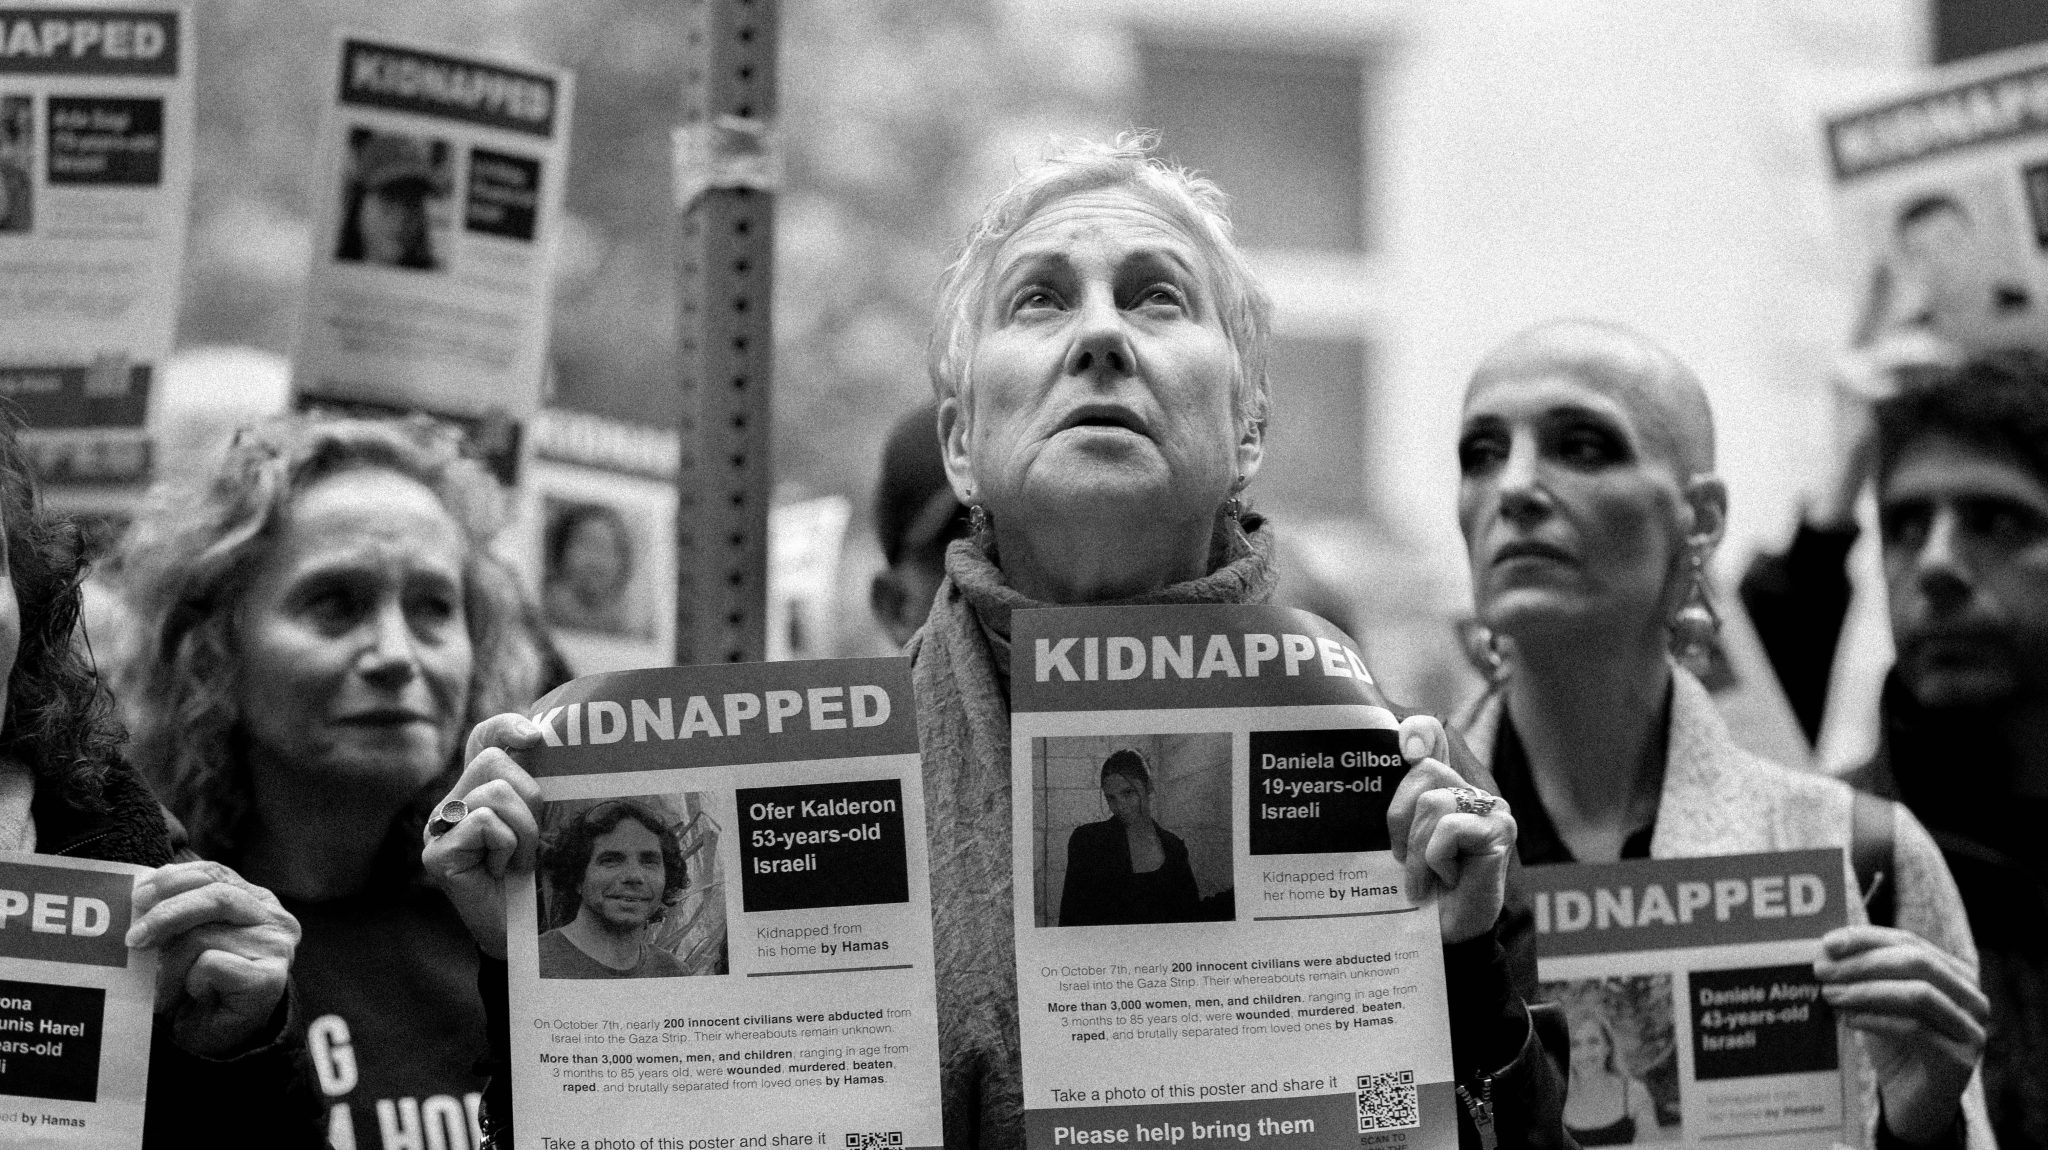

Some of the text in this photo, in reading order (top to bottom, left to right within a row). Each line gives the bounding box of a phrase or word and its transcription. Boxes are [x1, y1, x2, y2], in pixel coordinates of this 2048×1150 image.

[0, 19, 165, 60] APPED
[1034, 633, 1374, 685] KIDNAPPED
[531, 684, 891, 747] KIDNAPPED
[1262, 751, 1401, 769] Daniela Gilboa
[1262, 776, 1381, 797] 19-years-old
[749, 798, 895, 820] Ofer Kalderon
[1262, 802, 1319, 819] Israeli
[752, 822, 880, 849] 53-years-old
[753, 854, 816, 873] Israeli
[1262, 869, 1367, 883] Kidnapped from
[1264, 885, 1397, 900] her home by Hamas
[1534, 874, 1826, 934] IDNAPPED
[757, 923, 861, 939] Kidnapped from
[758, 940, 888, 957] his home by Hamas
[1041, 966, 1056, 976] On
[1061, 966, 1105, 975] October
[1134, 963, 1167, 974] nearly
[1171, 962, 1191, 972] 200
[1196, 961, 1247, 972] innocent
[1251, 959, 1299, 969] civilians
[1303, 957, 1332, 966] were
[1336, 952, 1390, 965] abducted
[1394, 950, 1418, 960] from
[1059, 970, 1346, 990] Israel into the Gaza Their whereabouts remain
[0, 997, 31, 1010] ona
[1048, 985, 1417, 1012] More than 3,000 women, men, and ranging in age from
[39, 1019, 84, 1036] Harel
[534, 1018, 549, 1028] On
[553, 1018, 597, 1029] October
[627, 1019, 659, 1030] nearly
[664, 1018, 683, 1027] 200
[688, 1016, 740, 1027] innocent
[743, 1014, 792, 1024] civilians
[796, 1013, 824, 1022] were
[828, 1009, 882, 1021] abducted
[886, 1008, 911, 1018] from
[1061, 1017, 1068, 1026] 3
[1071, 1016, 1112, 1026] months
[1116, 1016, 1126, 1024] to
[1130, 1015, 1142, 1024] 85
[1147, 1014, 1177, 1026] years
[1205, 1013, 1232, 1022] were
[551, 1034, 580, 1043] Israel
[584, 1034, 604, 1043] into
[608, 1034, 625, 1043] the
[628, 1033, 658, 1043] Gaza
[694, 1031, 721, 1041] Their
[725, 1028, 796, 1040] whereabouts
[801, 1027, 838, 1036] remain
[1112, 1030, 1133, 1039] and
[1137, 1027, 1177, 1040] brutally
[1182, 1026, 1238, 1038] separated
[1242, 1025, 1266, 1034] from
[1270, 1022, 1300, 1033] loved
[1304, 1021, 1331, 1031] ones
[1335, 1020, 1348, 1030] by
[307, 1013, 358, 1095] G
[539, 1053, 568, 1063] More
[572, 1054, 597, 1063] than
[601, 1054, 632, 1065] 3,000
[636, 1054, 682, 1063] women,
[686, 1054, 714, 1062] men,
[718, 1051, 739, 1060] and
[799, 1047, 841, 1059] ranging
[846, 1046, 855, 1054] in
[859, 1046, 880, 1056] age
[884, 1044, 908, 1053] from
[553, 1068, 559, 1076] 3
[563, 1068, 603, 1077] months
[607, 1068, 617, 1077] to
[621, 1068, 634, 1077] 85
[638, 1068, 667, 1079] years
[696, 1067, 722, 1076] were
[603, 1082, 623, 1092] and
[628, 1081, 667, 1093] brutally
[672, 1081, 728, 1092] separated
[733, 1079, 756, 1089] from
[761, 1077, 791, 1087] loved
[795, 1077, 821, 1086] ones
[826, 1076, 839, 1087] by
[1051, 1076, 1337, 1102] Take a photo of this poster and share it
[22, 1112, 36, 1125] by
[42, 1114, 85, 1127] Hamas
[541, 1131, 826, 1150] Take a photo of this poster and share it
[1053, 1117, 1314, 1145] Please help bring them
[1361, 1133, 1405, 1145] SCAN TO
